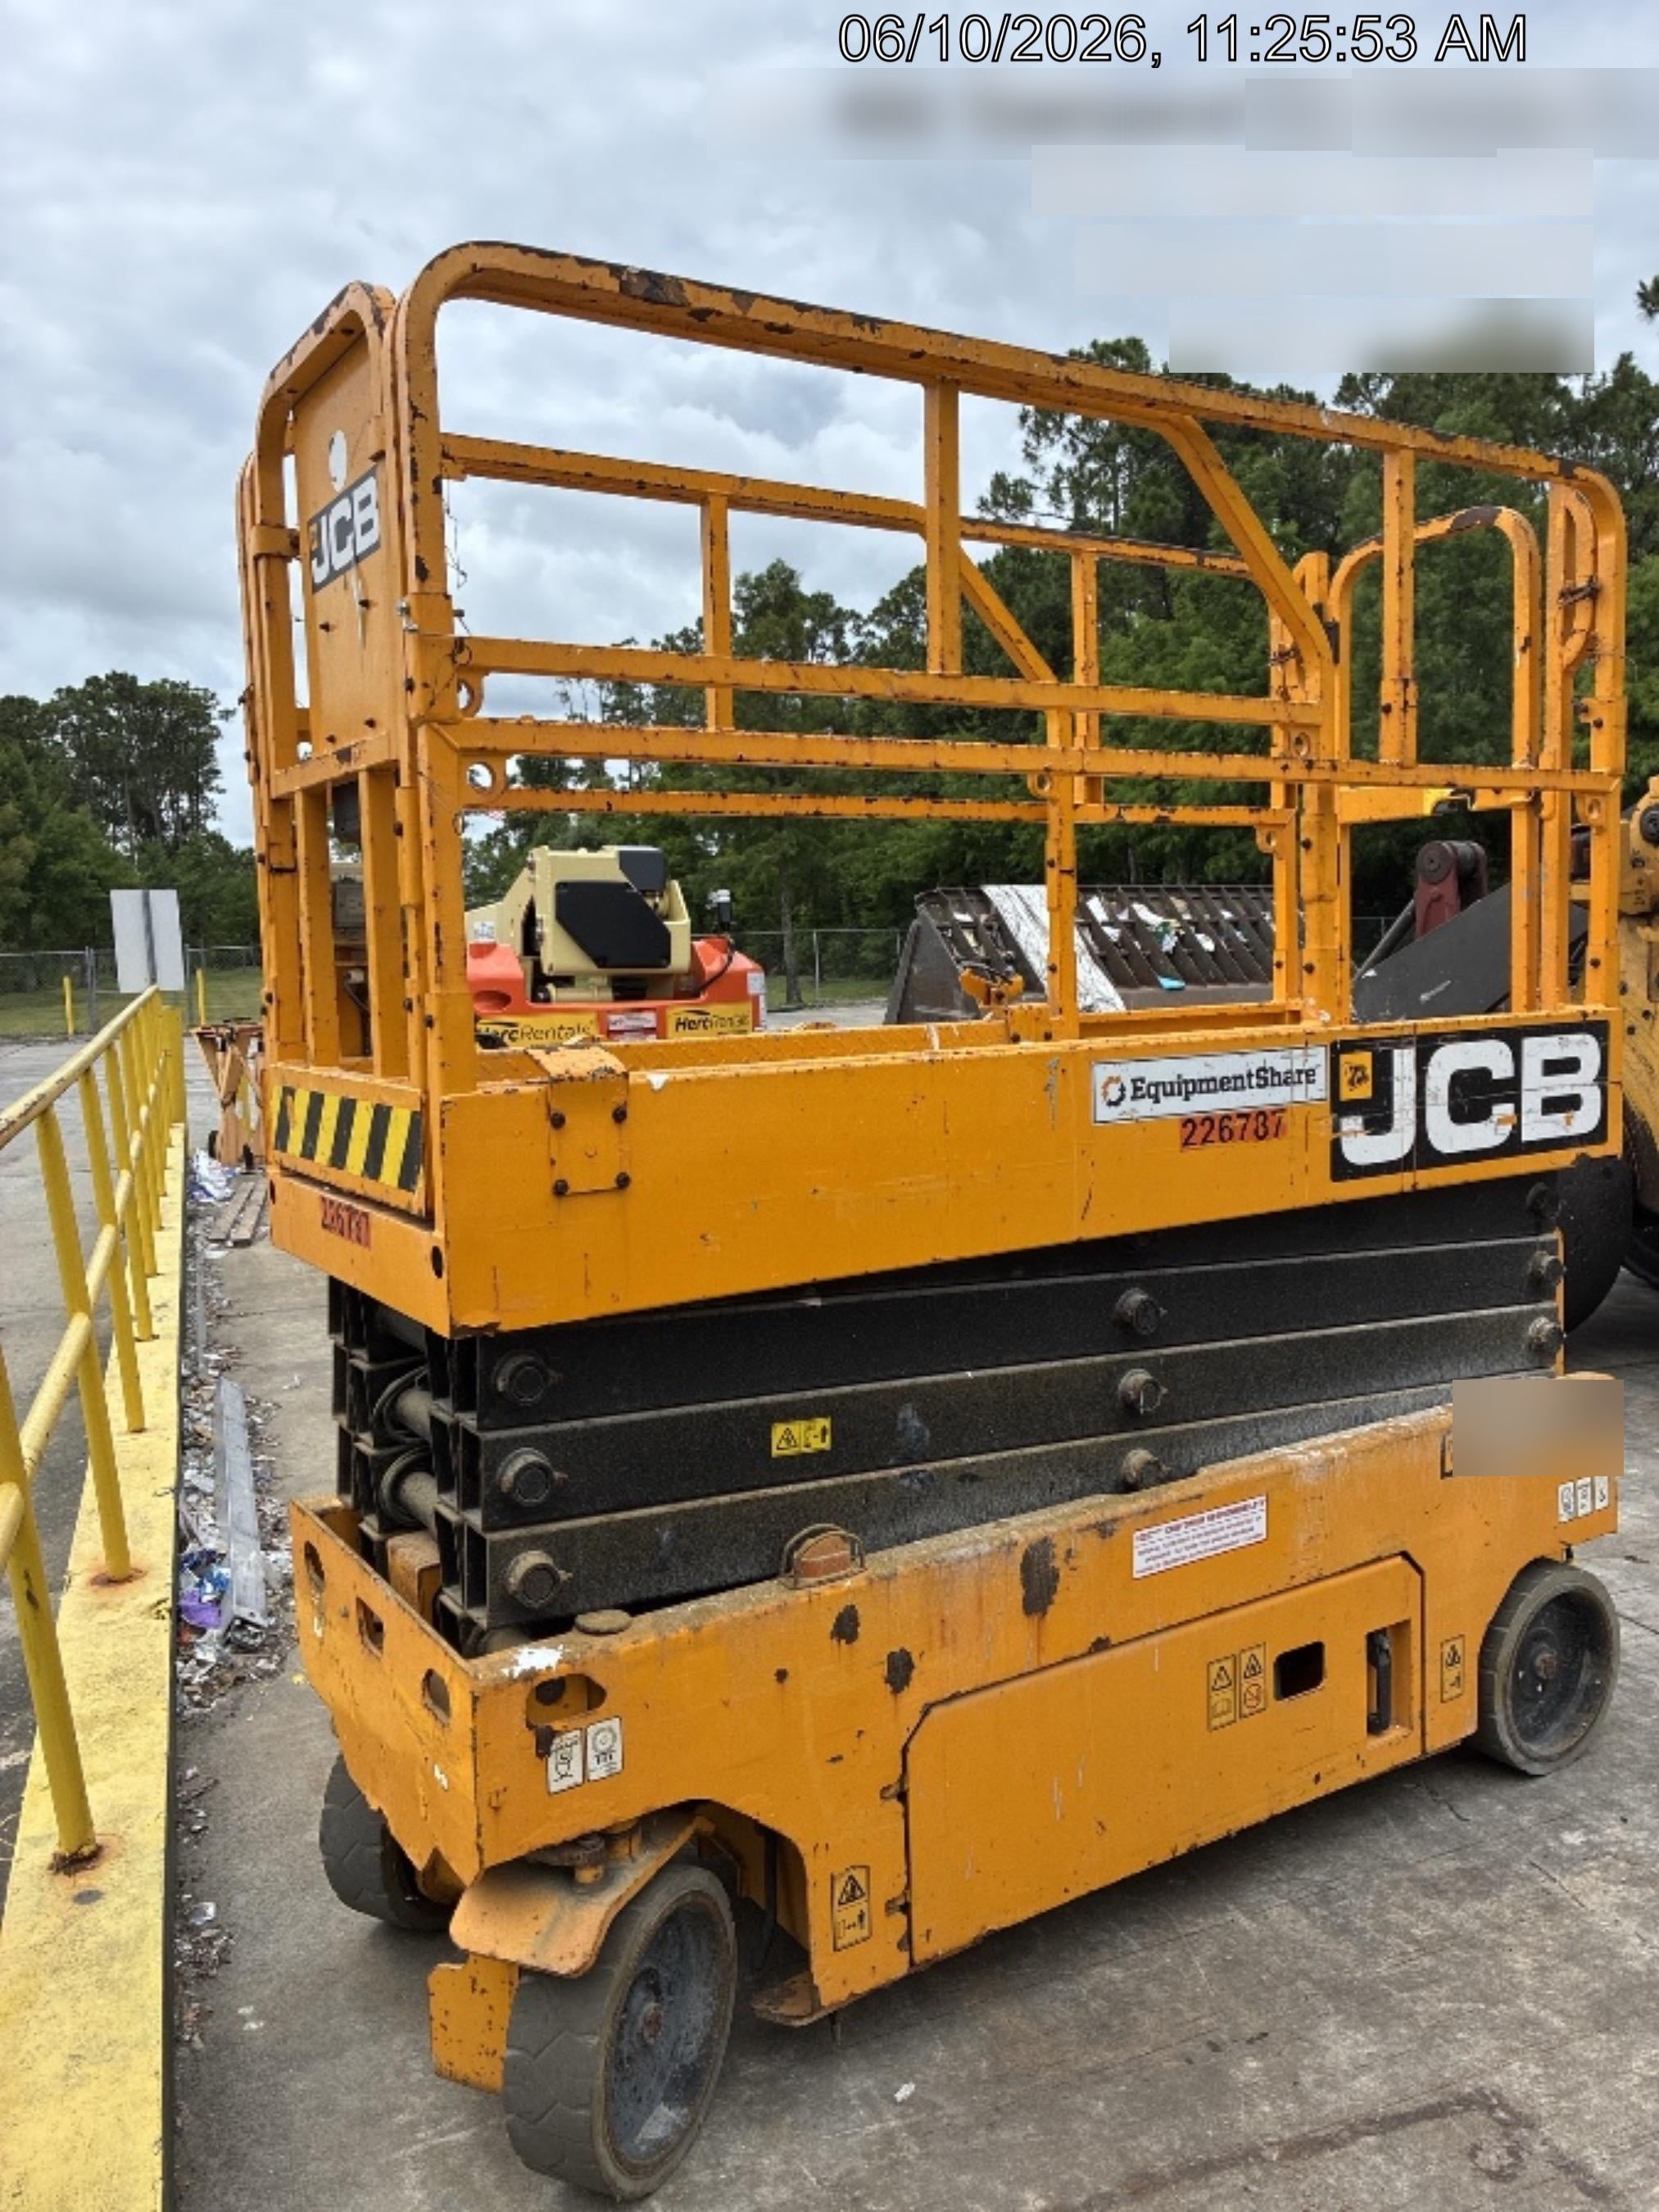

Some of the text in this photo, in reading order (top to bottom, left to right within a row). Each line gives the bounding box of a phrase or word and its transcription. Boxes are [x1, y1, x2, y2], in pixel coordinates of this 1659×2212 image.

[310, 475, 380, 584] JCB
[1130, 1065, 1317, 1104] EquipmentShare
[1339, 1033, 1602, 1166] JCB
[1181, 1107, 1286, 1147] 226787
